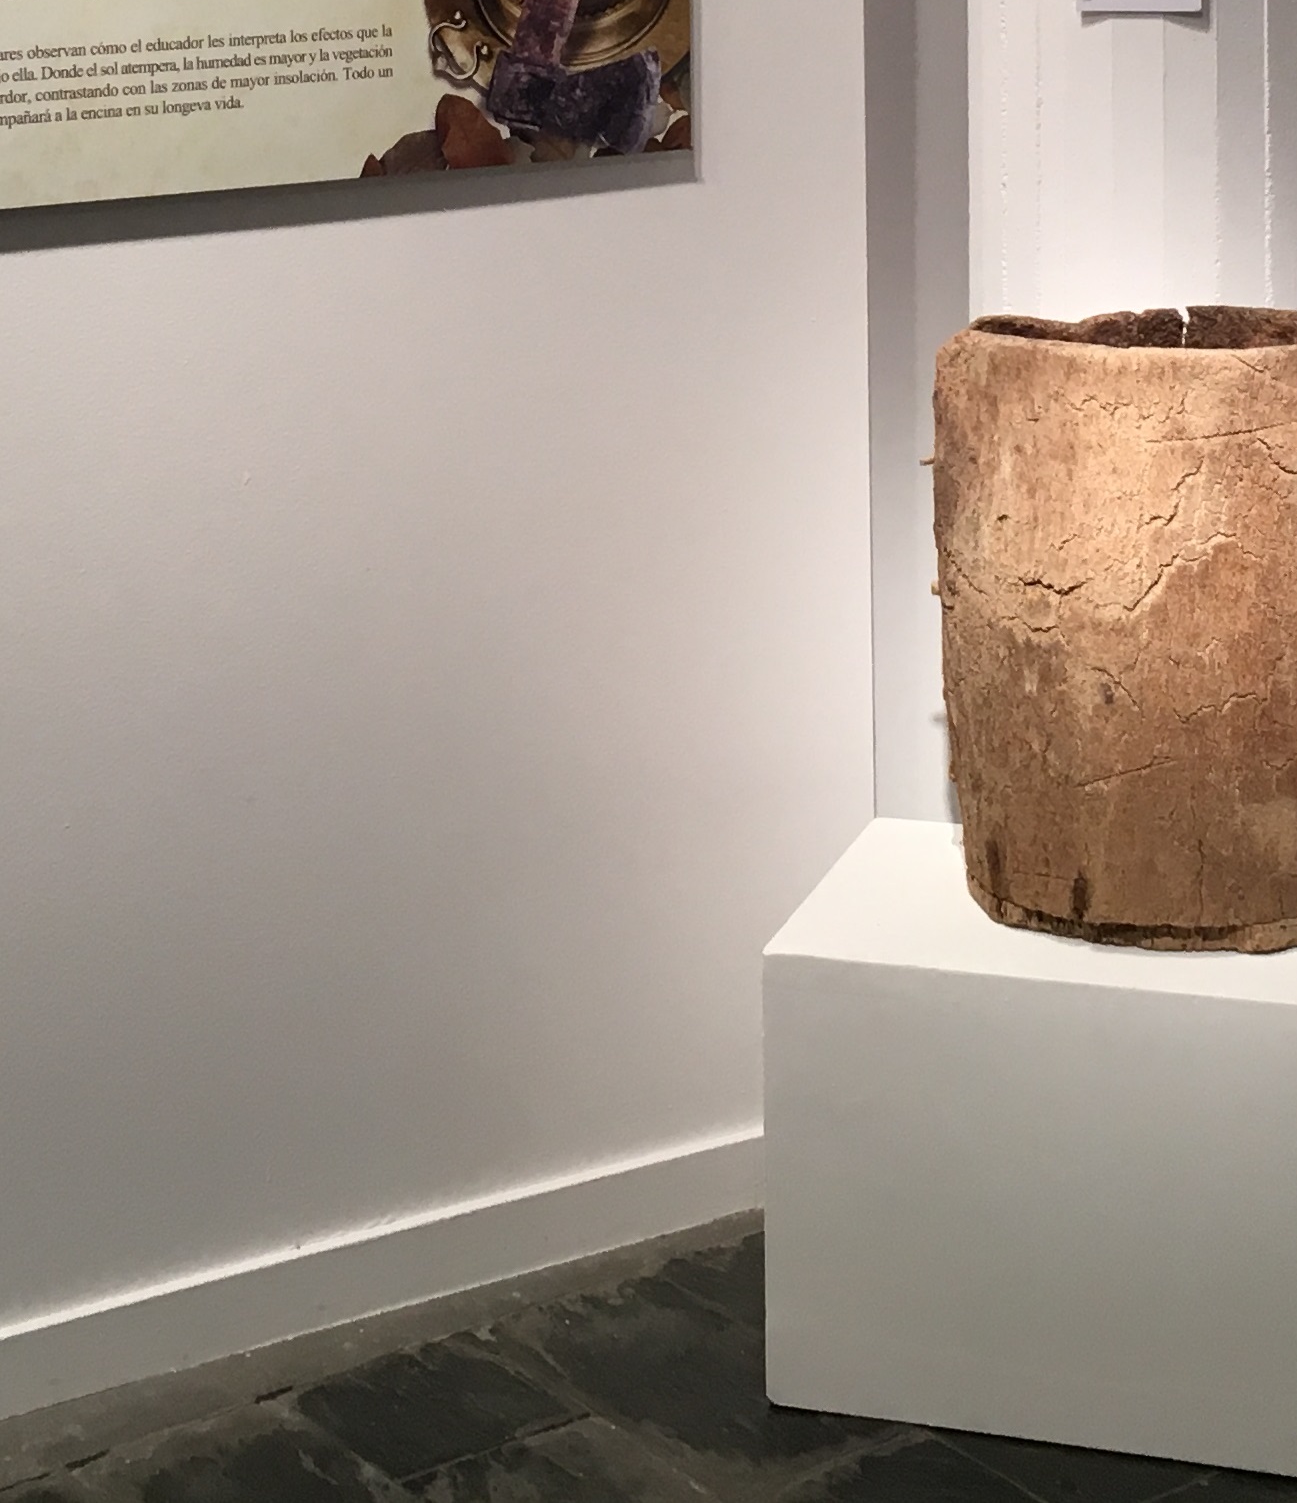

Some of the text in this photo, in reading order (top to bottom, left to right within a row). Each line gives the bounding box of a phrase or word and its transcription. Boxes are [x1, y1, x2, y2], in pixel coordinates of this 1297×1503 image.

[26, 44, 86, 60] observan
[89, 41, 127, 56] cómo
[130, 38, 142, 53] el
[145, 35, 204, 52] educador
[207, 34, 225, 48] les
[228, 32, 286, 49] interpreta
[289, 28, 308, 43] los
[310, 26, 353, 42] efectos
[356, 27, 378, 42] que
[381, 23, 392, 37] la
[34, 82, 119, 102] contrastando
[121, 84, 146, 96] con
[149, 79, 168, 94] las
[171, 80, 208, 92] zonas
[210, 75, 227, 90] de
[229, 75, 270, 91] mayor
[342, 65, 375, 80] Todo
[377, 67, 393, 78] un
[54, 111, 62, 122] a
[65, 106, 78, 121] la
[80, 104, 123, 120] encina
[125, 105, 141, 117] en
[144, 104, 158, 115] su
[162, 100, 211, 117] longeva
